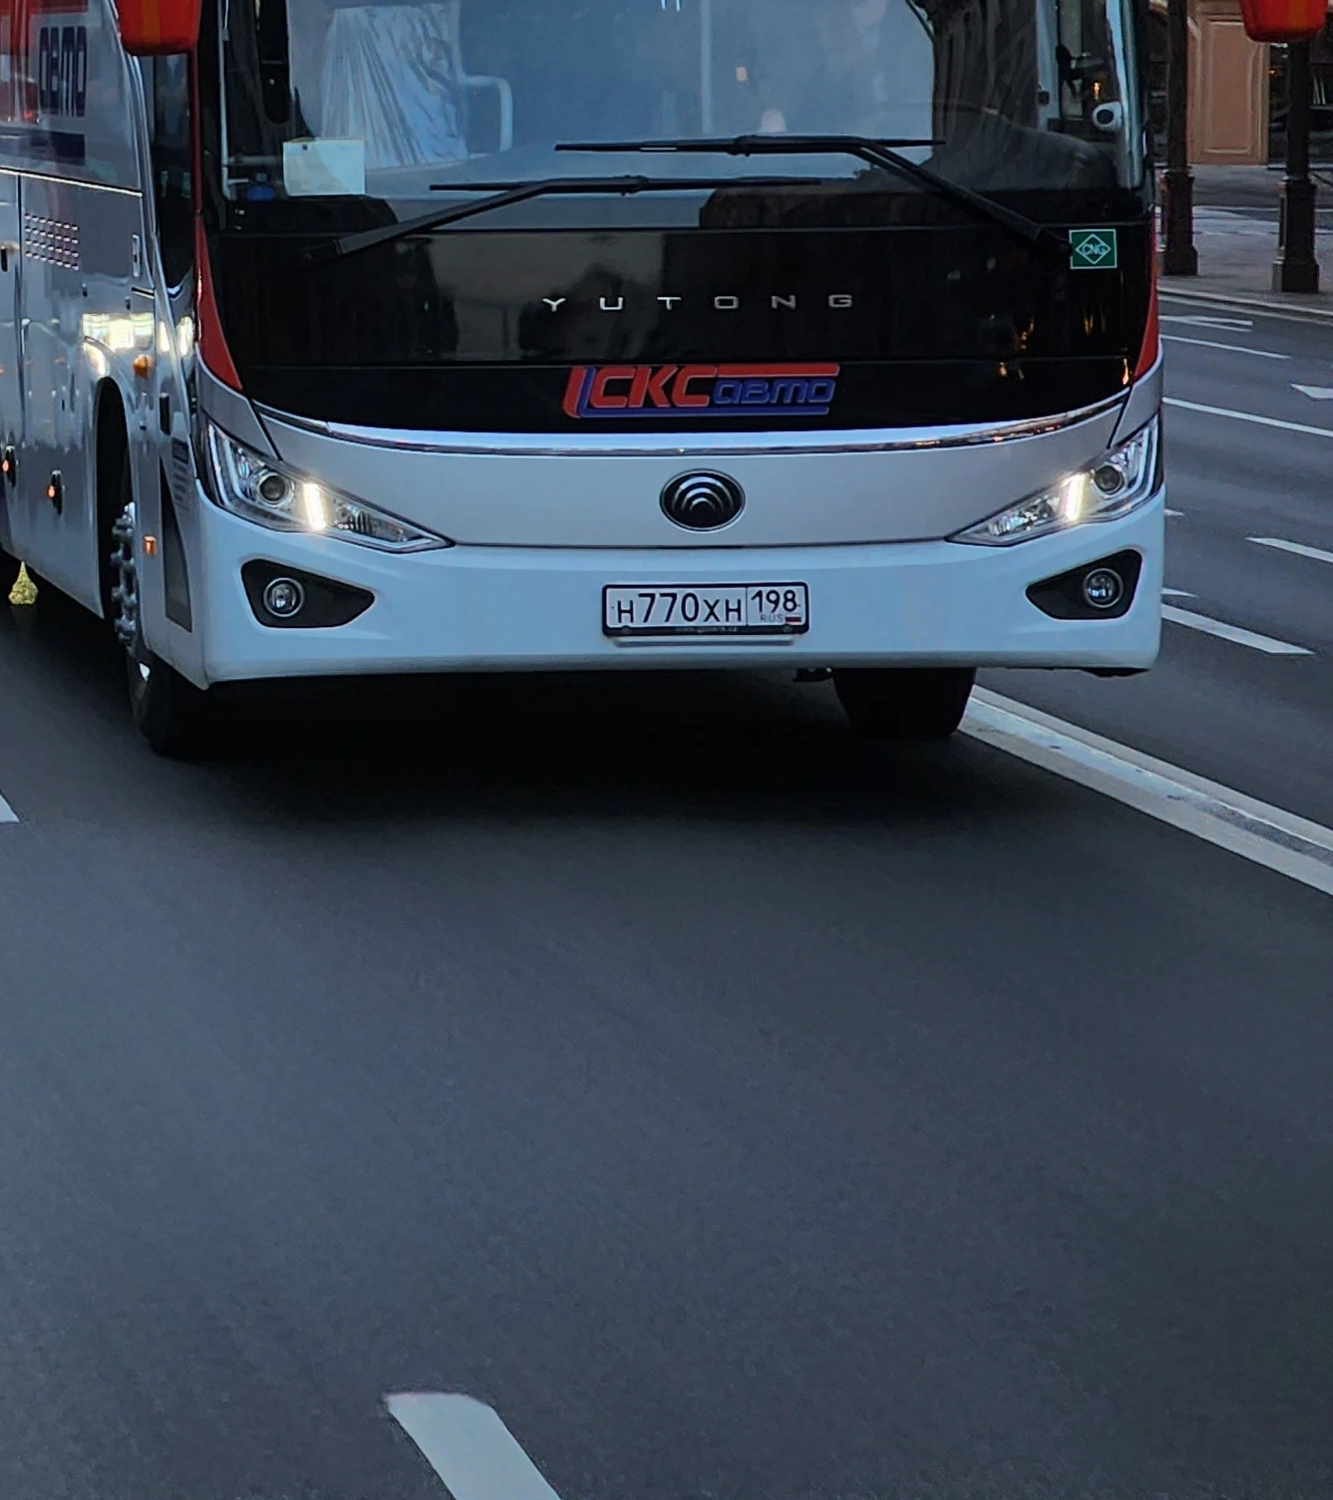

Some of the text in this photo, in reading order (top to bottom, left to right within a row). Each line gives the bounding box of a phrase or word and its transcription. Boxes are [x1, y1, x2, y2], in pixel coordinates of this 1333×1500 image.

[1081, 243, 1106, 256] CNG
[541, 293, 853, 312] YUTONG
[751, 589, 798, 614] 198
[759, 613, 784, 623] RUS
